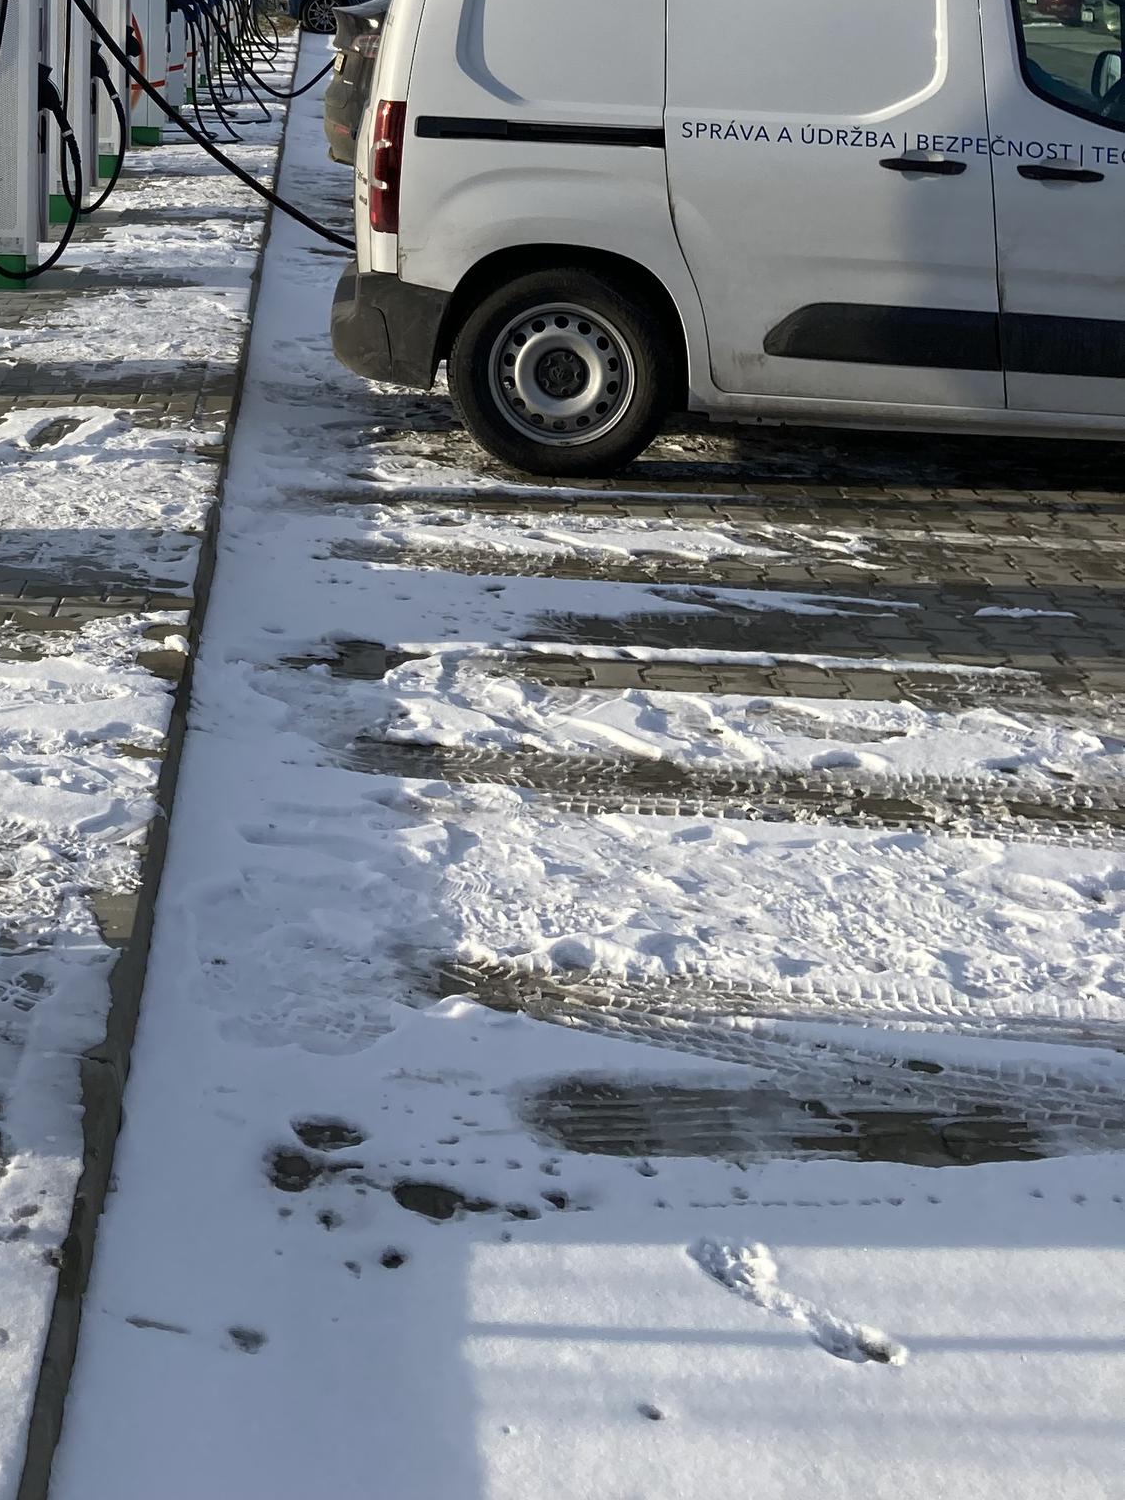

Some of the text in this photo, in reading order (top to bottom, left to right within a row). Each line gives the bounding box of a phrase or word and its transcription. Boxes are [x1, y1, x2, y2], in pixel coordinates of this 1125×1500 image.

[682, 120, 770, 142] SPRÁVA
[777, 127, 793, 143] A
[801, 124, 896, 149] ÚDRŽBA
[917, 134, 1073, 161] BEZPEČNOST
